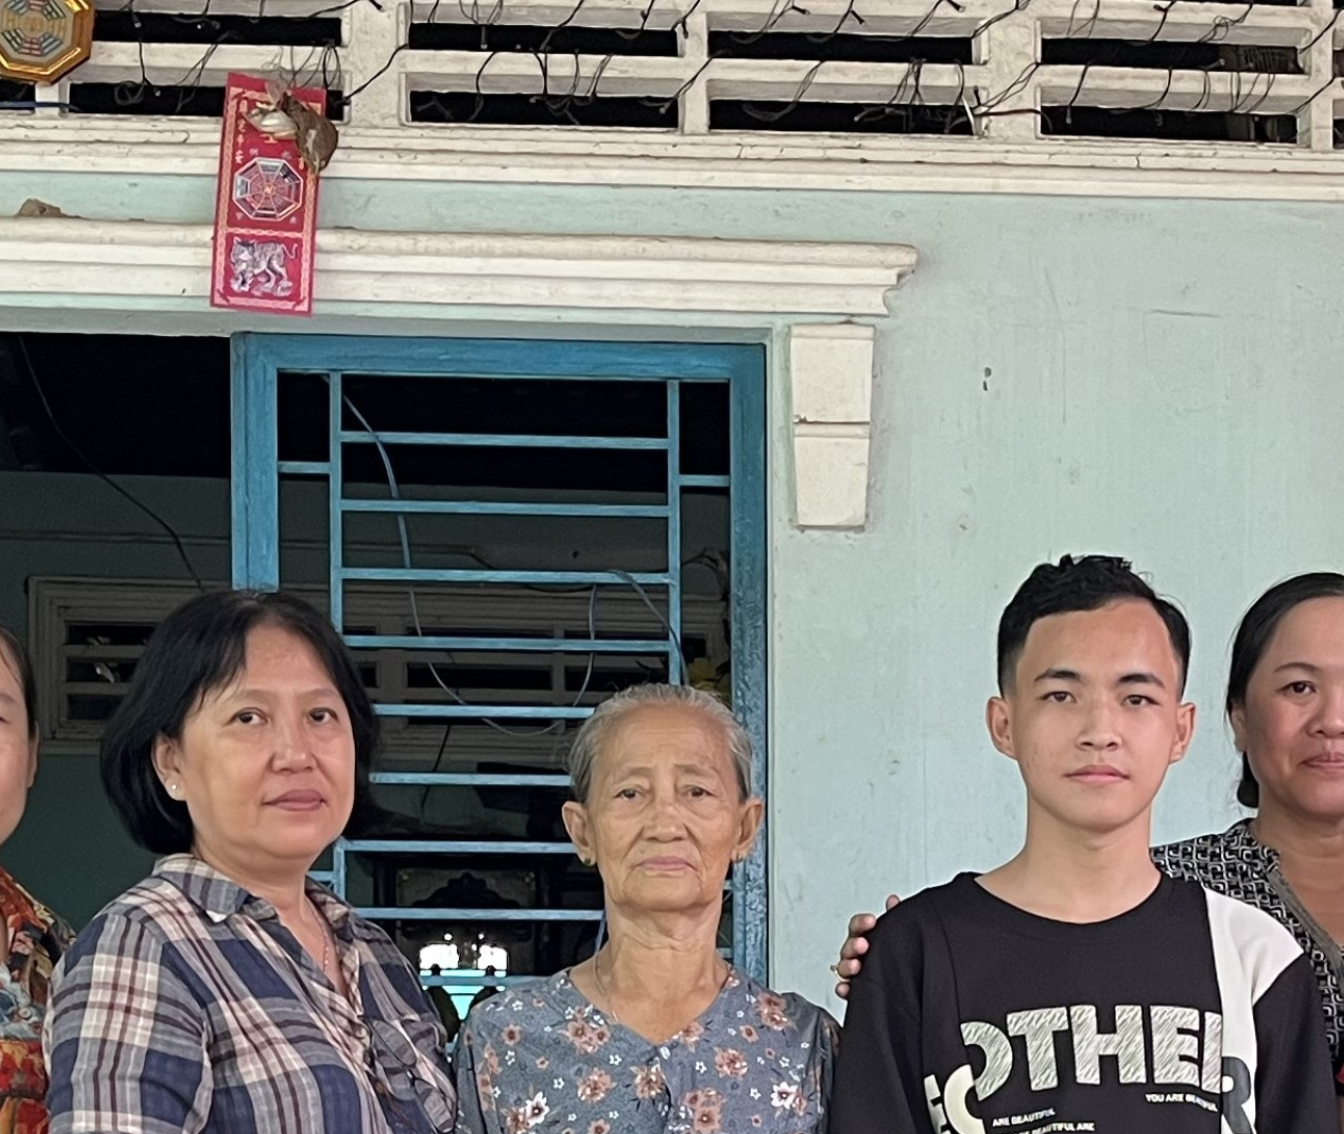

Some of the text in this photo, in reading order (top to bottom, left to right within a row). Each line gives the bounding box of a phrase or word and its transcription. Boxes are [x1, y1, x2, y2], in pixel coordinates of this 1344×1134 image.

[1145, 1093, 1165, 1103] YOU
[1165, 1093, 1185, 1103] ARE
[992, 1116, 1011, 1128] ARE
[1075, 1122, 1096, 1132] ARE
